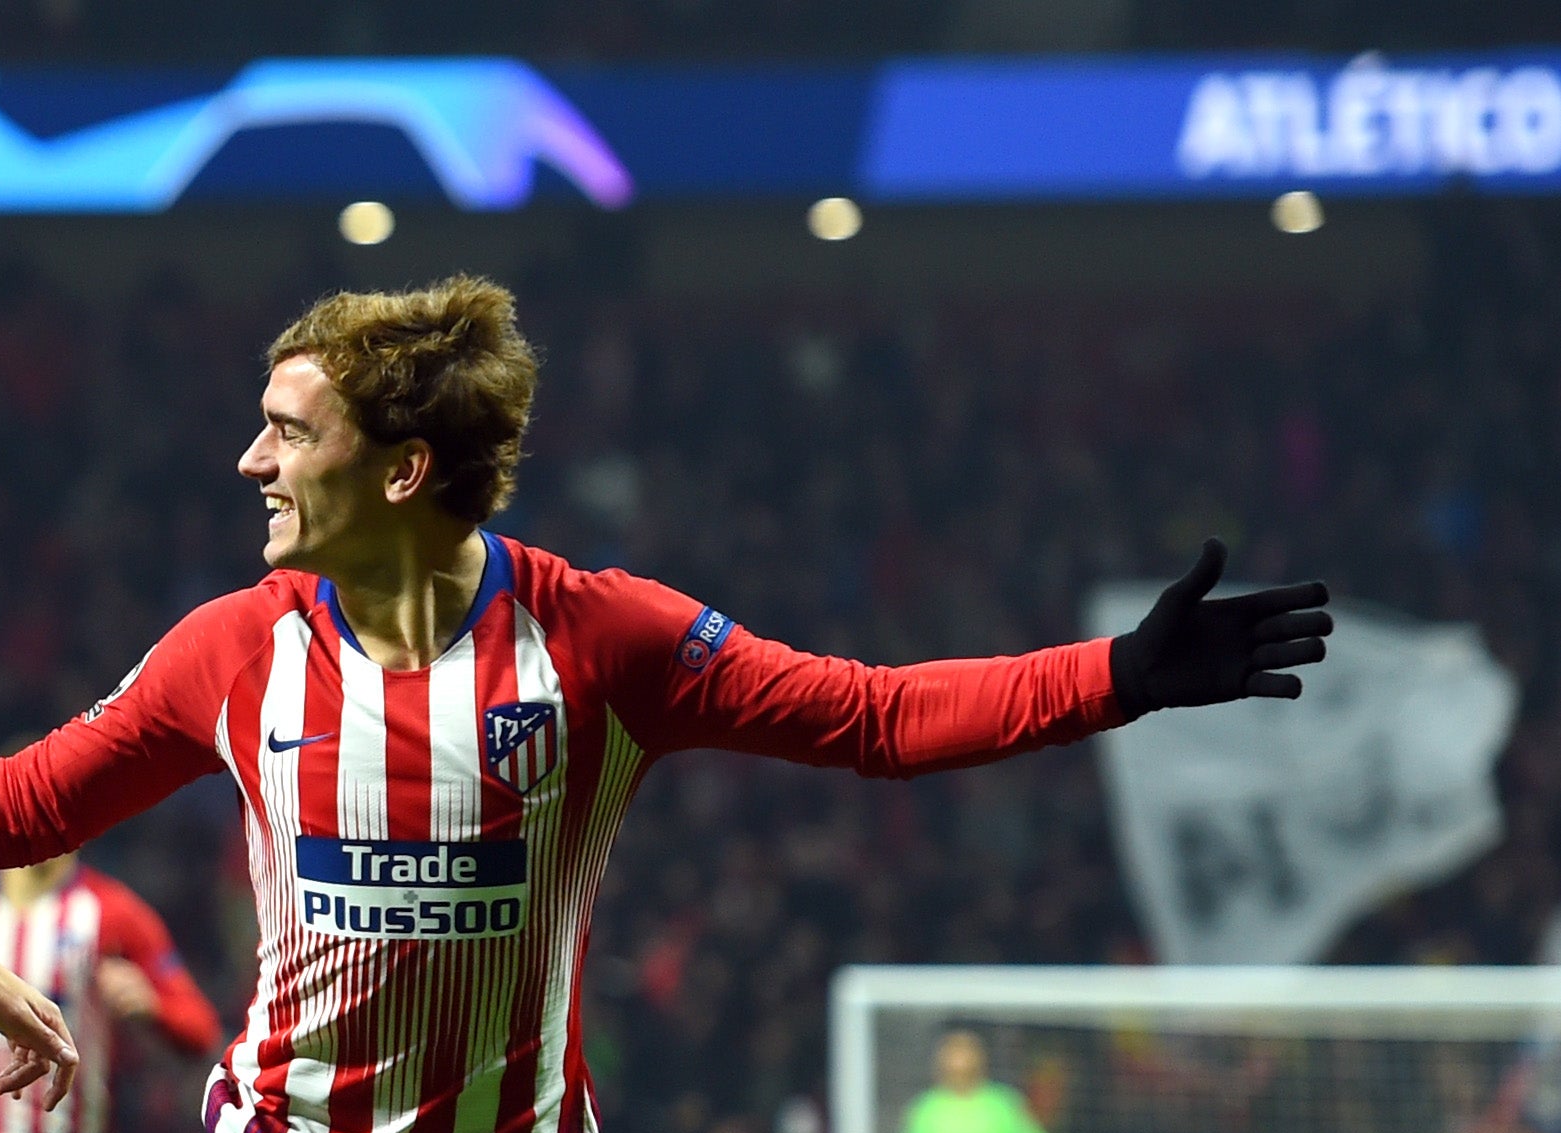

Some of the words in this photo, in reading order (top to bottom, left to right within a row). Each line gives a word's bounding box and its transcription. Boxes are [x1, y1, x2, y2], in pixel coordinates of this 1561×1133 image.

[1178, 51, 1561, 178] ATLÉTICO
[342, 845, 477, 883] Trade
[304, 890, 521, 934] Plus500
